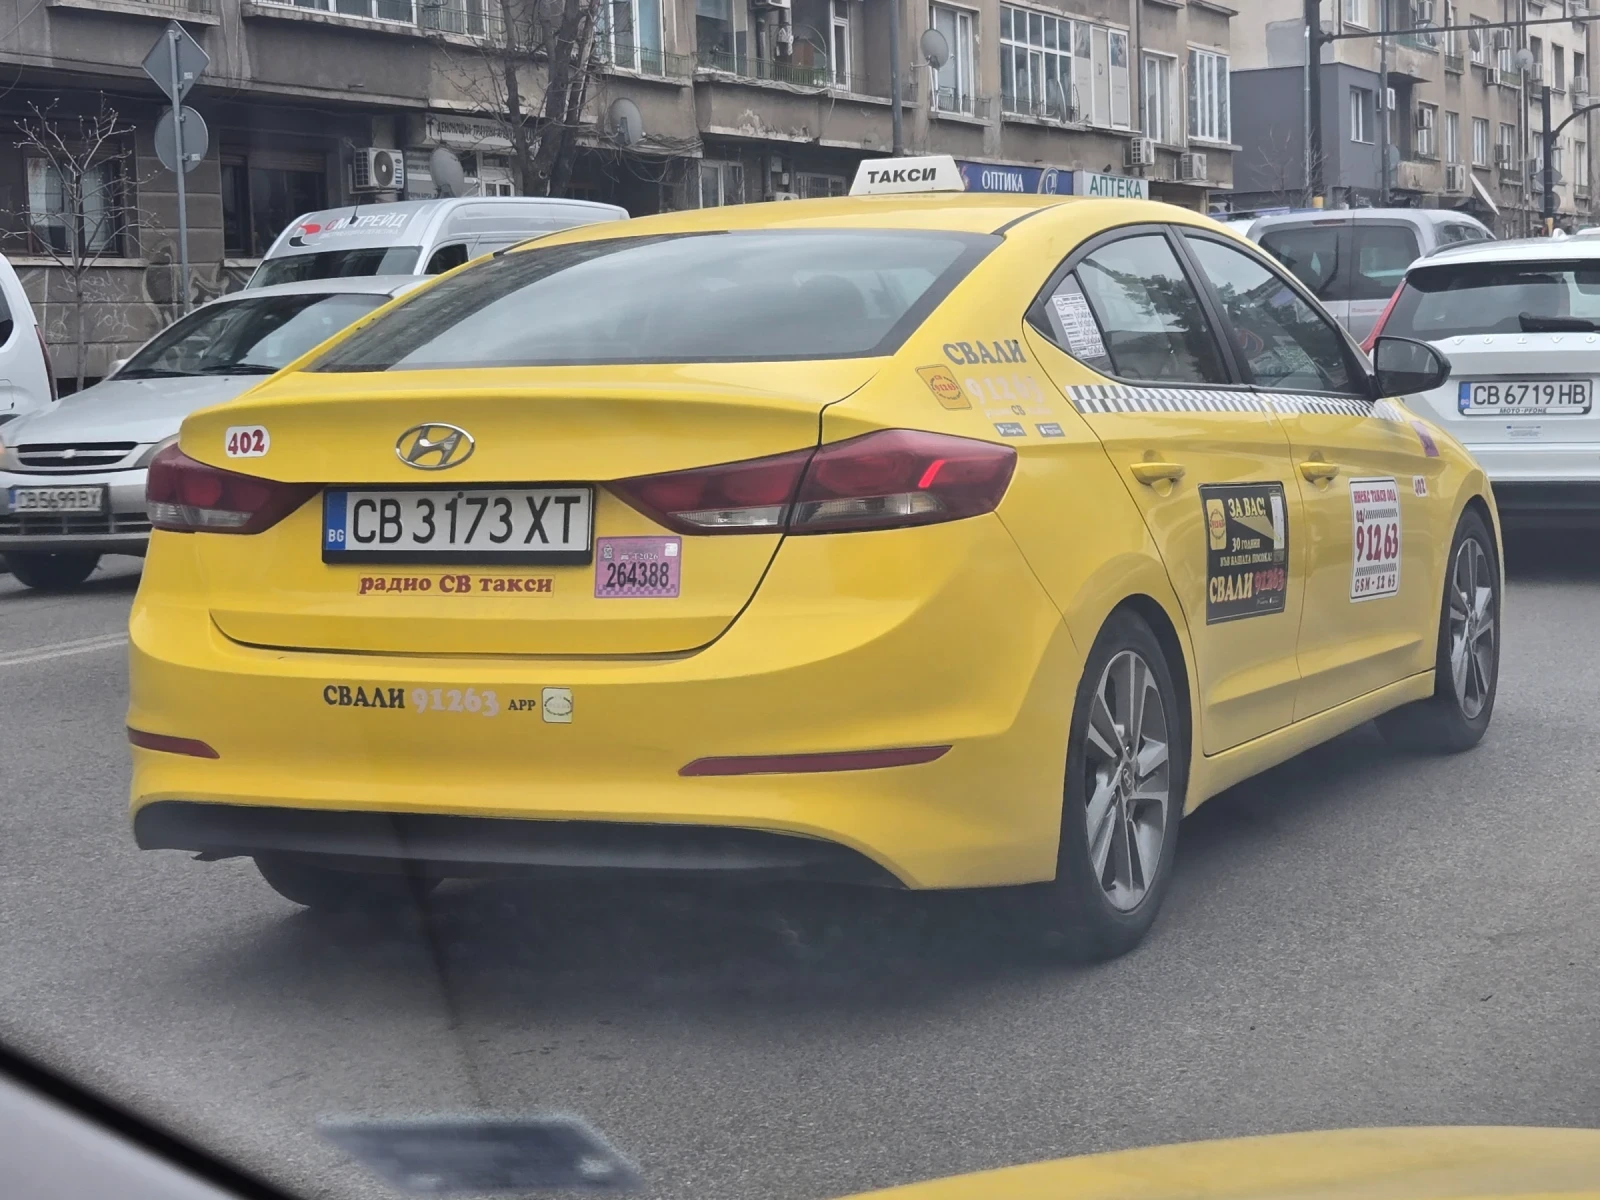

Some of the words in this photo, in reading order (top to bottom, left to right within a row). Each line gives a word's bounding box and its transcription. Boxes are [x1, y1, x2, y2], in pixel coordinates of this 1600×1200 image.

[867, 167, 937, 184] ТАКСИ
[981, 170, 1024, 192] ОПТИКА
[1089, 174, 1143, 199] АПТЕКА
[353, 212, 408, 228] ТРЕЙД
[1452, 336, 1597, 345] VOLVO
[943, 339, 1027, 365] СВАЛИ
[1473, 385, 1500, 405] CB
[1504, 384, 1555, 405] 6719
[1558, 384, 1586, 405] HB
[228, 429, 265, 455] 402
[1228, 498, 1243, 518] ЗА
[1243, 497, 1266, 517] ВАС!
[353, 498, 402, 543] CB
[413, 497, 512, 543] 3173
[523, 496, 581, 543] XT
[328, 529, 344, 542] BG
[1231, 537, 1241, 552] 30
[359, 576, 431, 594] радио
[439, 575, 472, 593] СВ
[479, 577, 552, 593] такси
[606, 562, 669, 587] 264388
[1355, 577, 1371, 593] GSM
[1209, 572, 1253, 604] СВАЛИ
[1254, 568, 1285, 594] 91263
[323, 685, 405, 709] СВАЛИ
[411, 687, 500, 717] 91263
